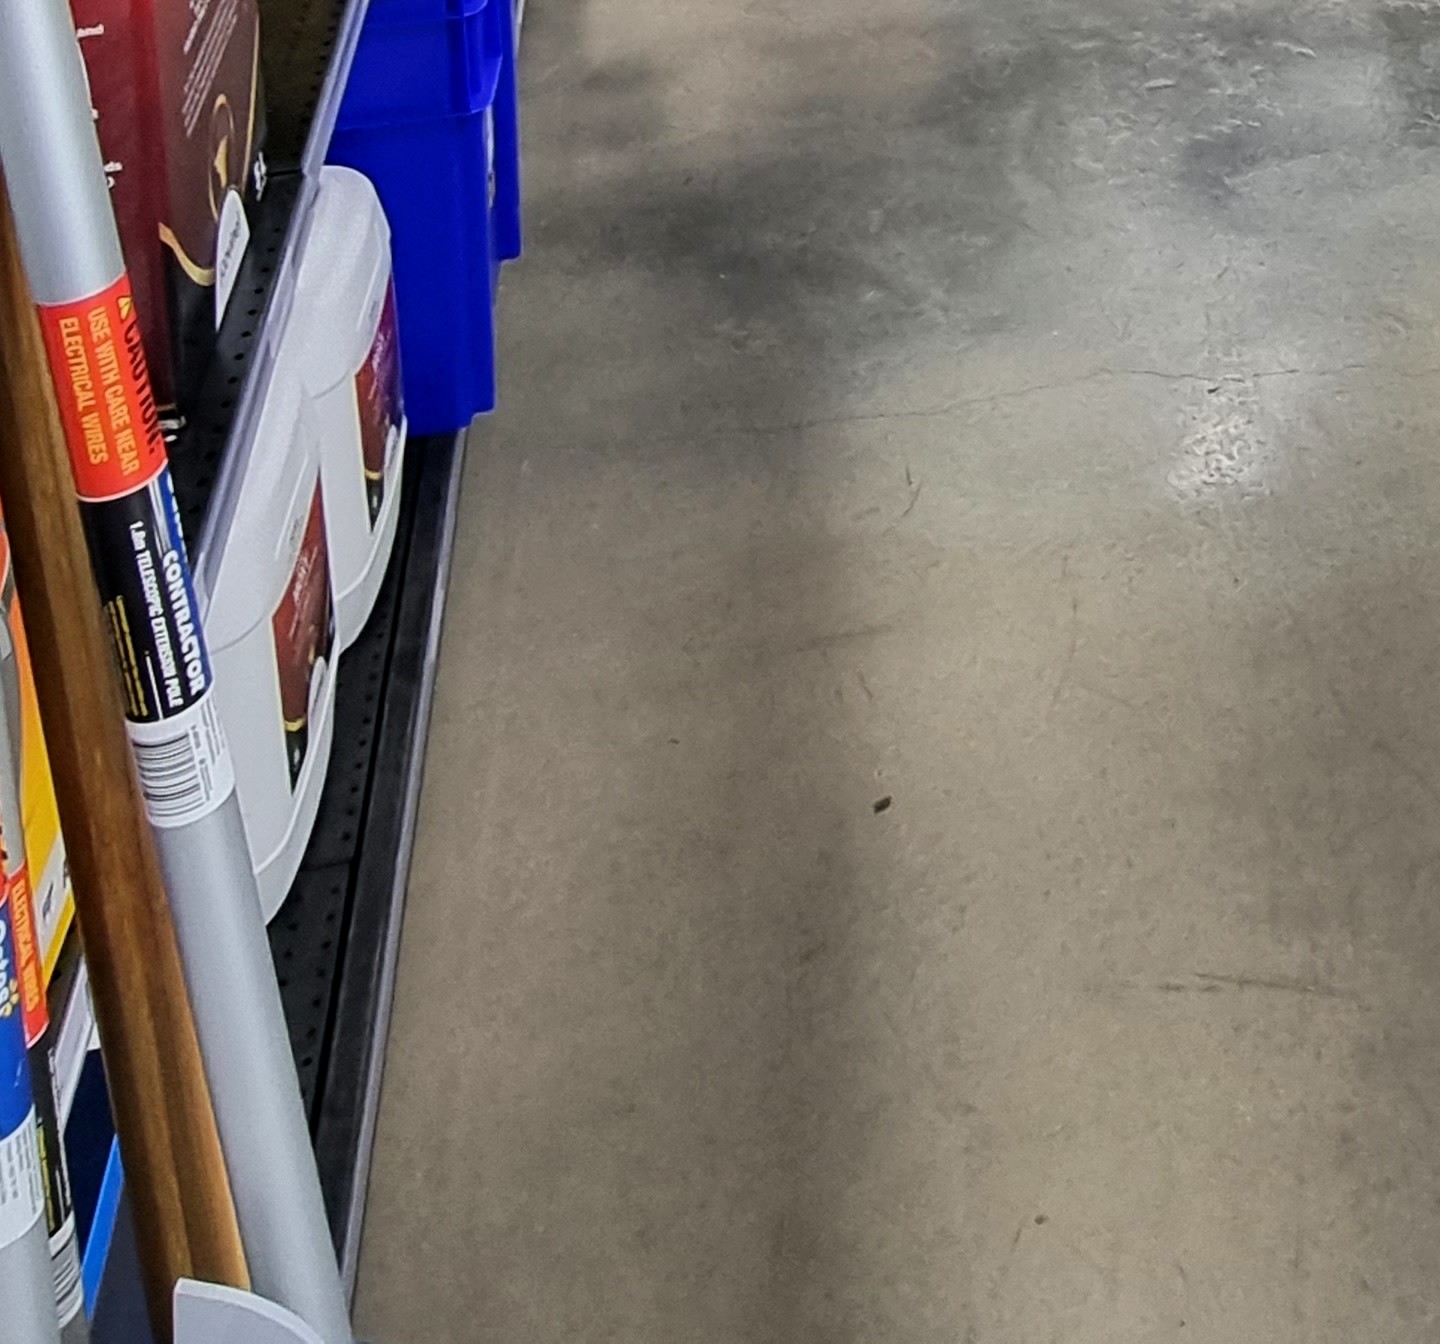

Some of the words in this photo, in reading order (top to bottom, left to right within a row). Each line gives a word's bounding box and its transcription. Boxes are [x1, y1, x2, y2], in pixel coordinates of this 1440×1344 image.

[87, 306, 112, 344] USE
[94, 340, 122, 386] WITH
[59, 316, 97, 412] ELECTRICAL
[81, 411, 109, 466] WIRES
[104, 384, 132, 431] CARE
[115, 428, 141, 477] NEAR
[136, 549, 164, 618] TELESCOPIC
[151, 616, 177, 678] EXTENSION
[164, 677, 185, 709] POLE
[162, 550, 205, 696] CONTRACTOR
